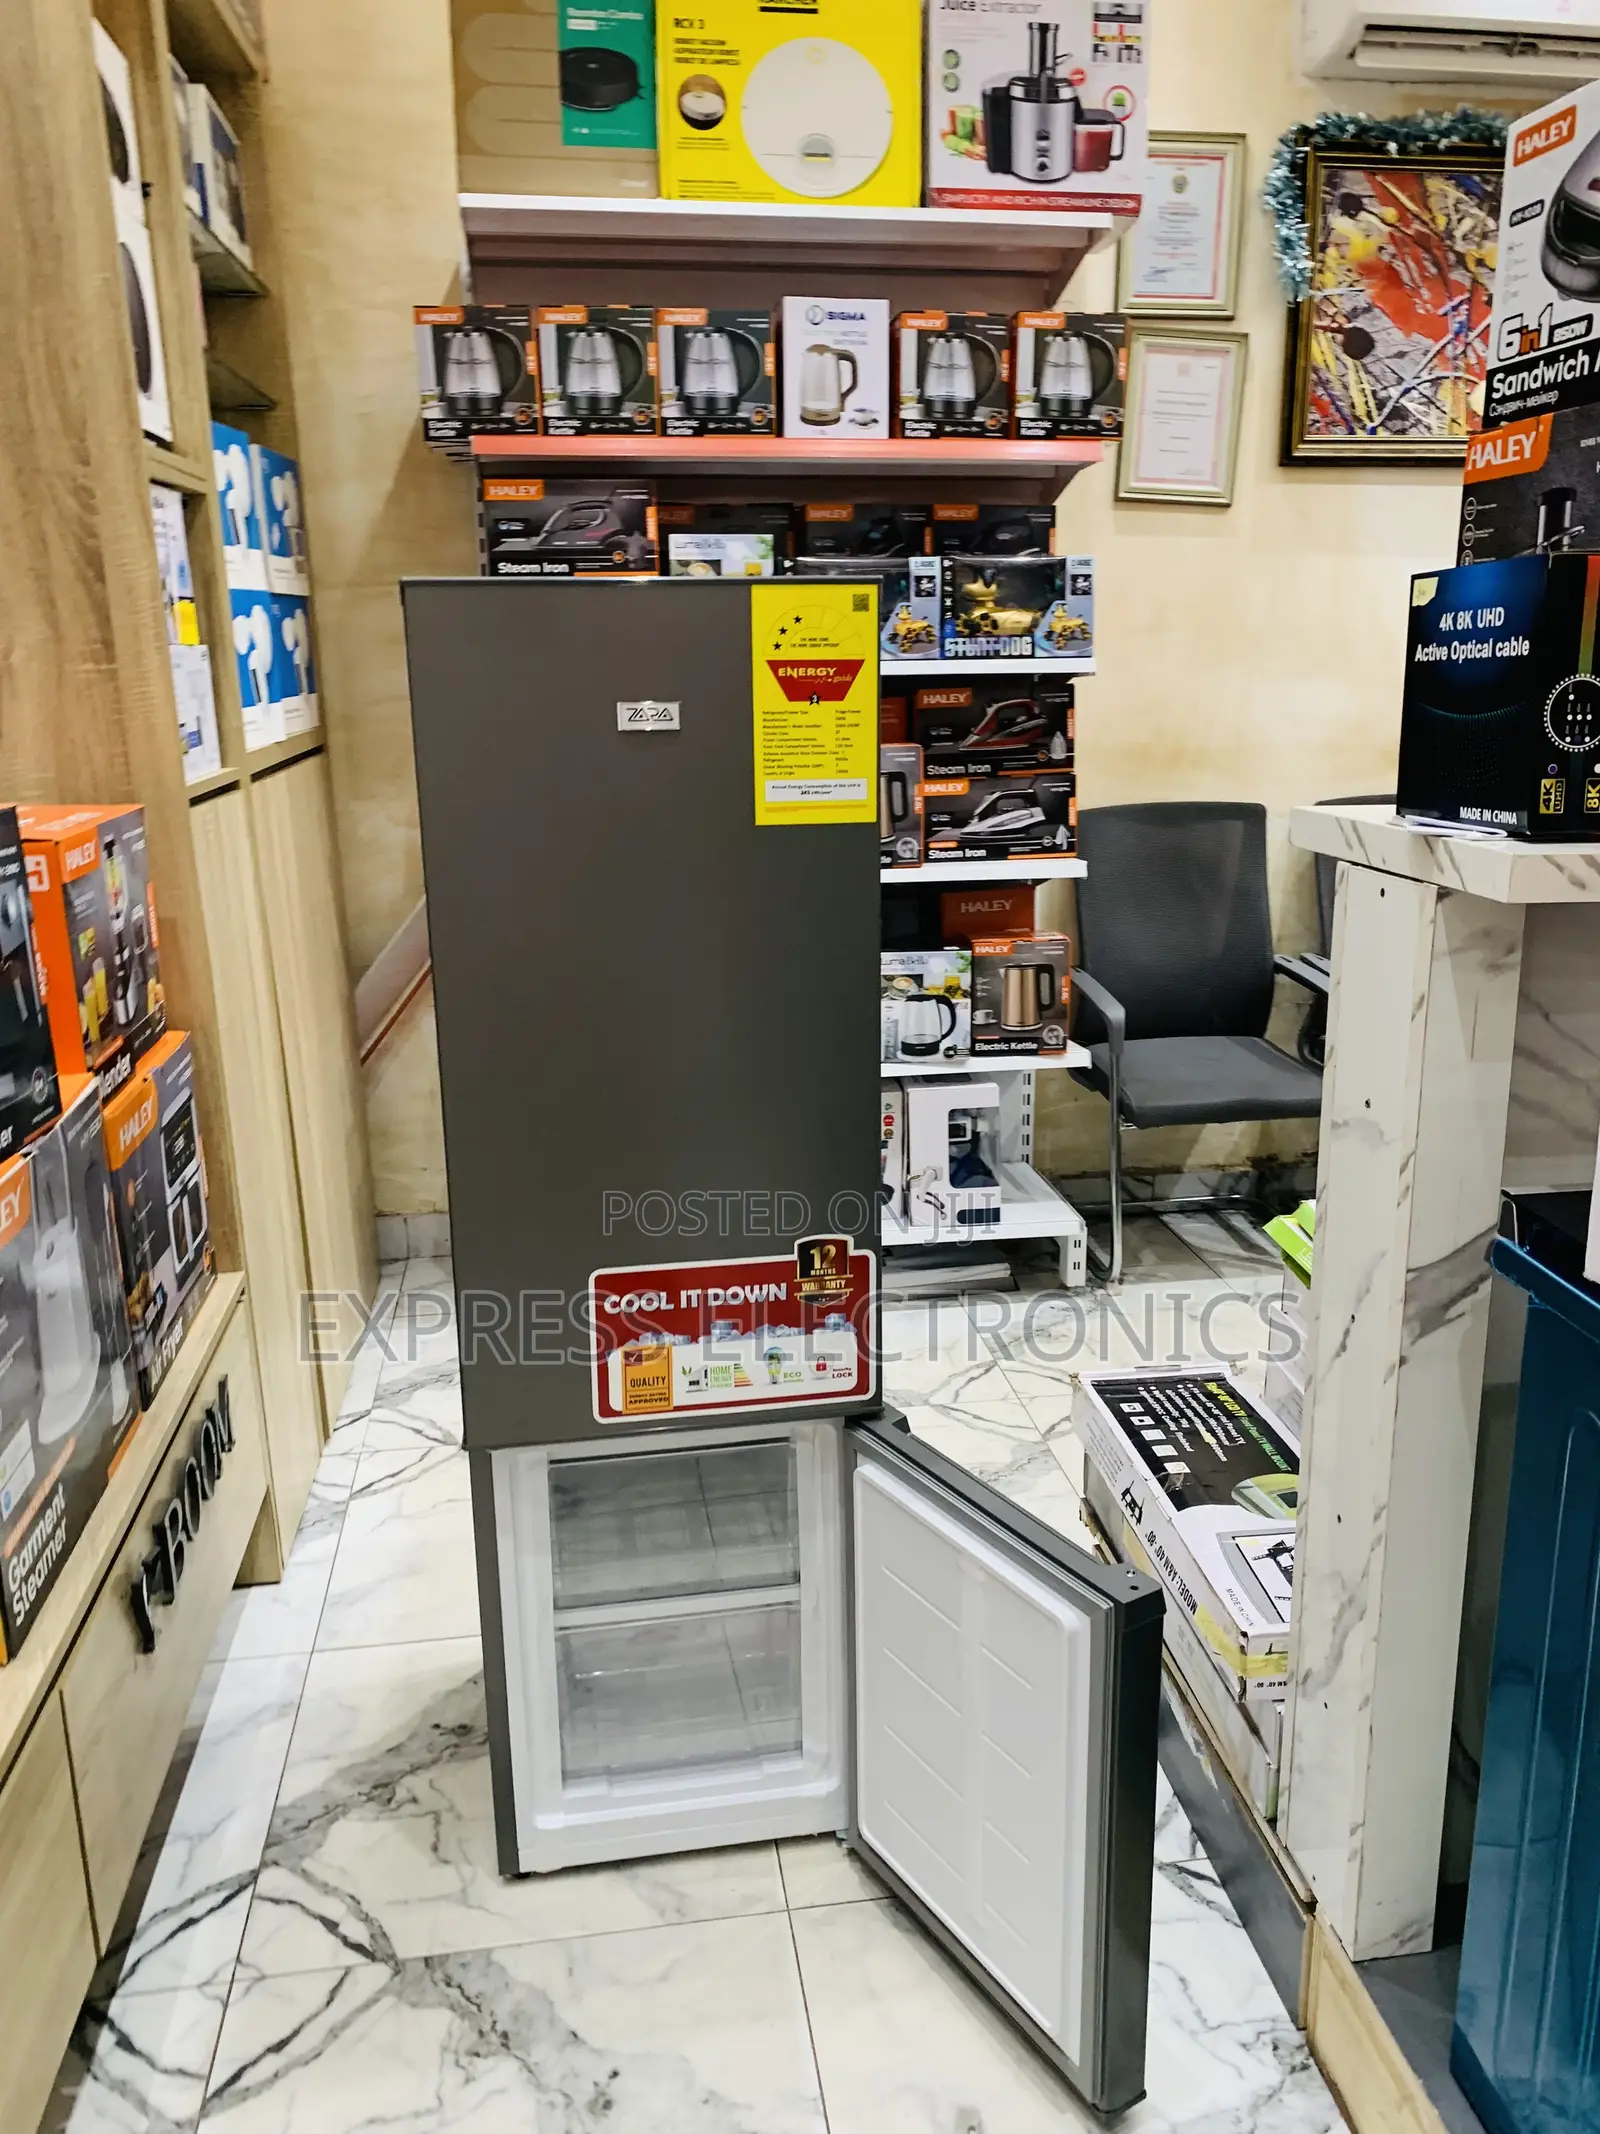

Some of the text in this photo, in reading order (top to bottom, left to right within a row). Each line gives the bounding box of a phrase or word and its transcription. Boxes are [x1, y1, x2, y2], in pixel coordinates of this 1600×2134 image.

[1516, 114, 1572, 159] HALEY
[827, 311, 866, 321] SIGMA
[1553, 320, 1588, 343] 850W
[1491, 349, 1590, 399] Sandwich
[429, 420, 463, 428] Electric
[547, 418, 582, 428] Electric
[666, 418, 700, 428] Electric
[904, 420, 938, 430] Electric
[1019, 419, 1053, 429] Electric
[1466, 430, 1537, 471] HALEY
[489, 485, 538, 496] HALEY
[497, 562, 570, 574] Steam Iron
[1438, 606, 1505, 631] 4K 8K UHD
[999, 636, 1033, 656] DOG
[1414, 636, 1530, 664] Active Optical cable
[778, 666, 838, 679] ENERGY
[923, 693, 968, 705] HALEY
[926, 763, 992, 775] Steam Iron
[924, 783, 965, 793] HALEY
[1542, 782, 1554, 812] 4K
[1554, 782, 1563, 810] UHD
[1587, 783, 1600, 809] 8K
[1459, 806, 1518, 825] MADE IN CHINA
[928, 848, 987, 859] Steam Iron
[960, 899, 1013, 913] HALEY
[975, 945, 1010, 954] HALEY
[975, 1041, 1038, 1051] Electric Kettle
[119, 1096, 153, 1153] HALEY
[810, 1244, 837, 1270] 12
[810, 1268, 836, 1276] MONTHS
[603, 1282, 787, 1315] COOL IT DOWN
[710, 1365, 733, 1375] HOME
[783, 1371, 802, 1379] ECO
[630, 1376, 667, 1388] QUALITY
[628, 1396, 669, 1405] APPROVED
[8, 1481, 66, 1592] Garment
[12, 1516, 67, 1628] Steamer
[1172, 1575, 1201, 1615] MODEL:
[1225, 1588, 1241, 1608] MADE
